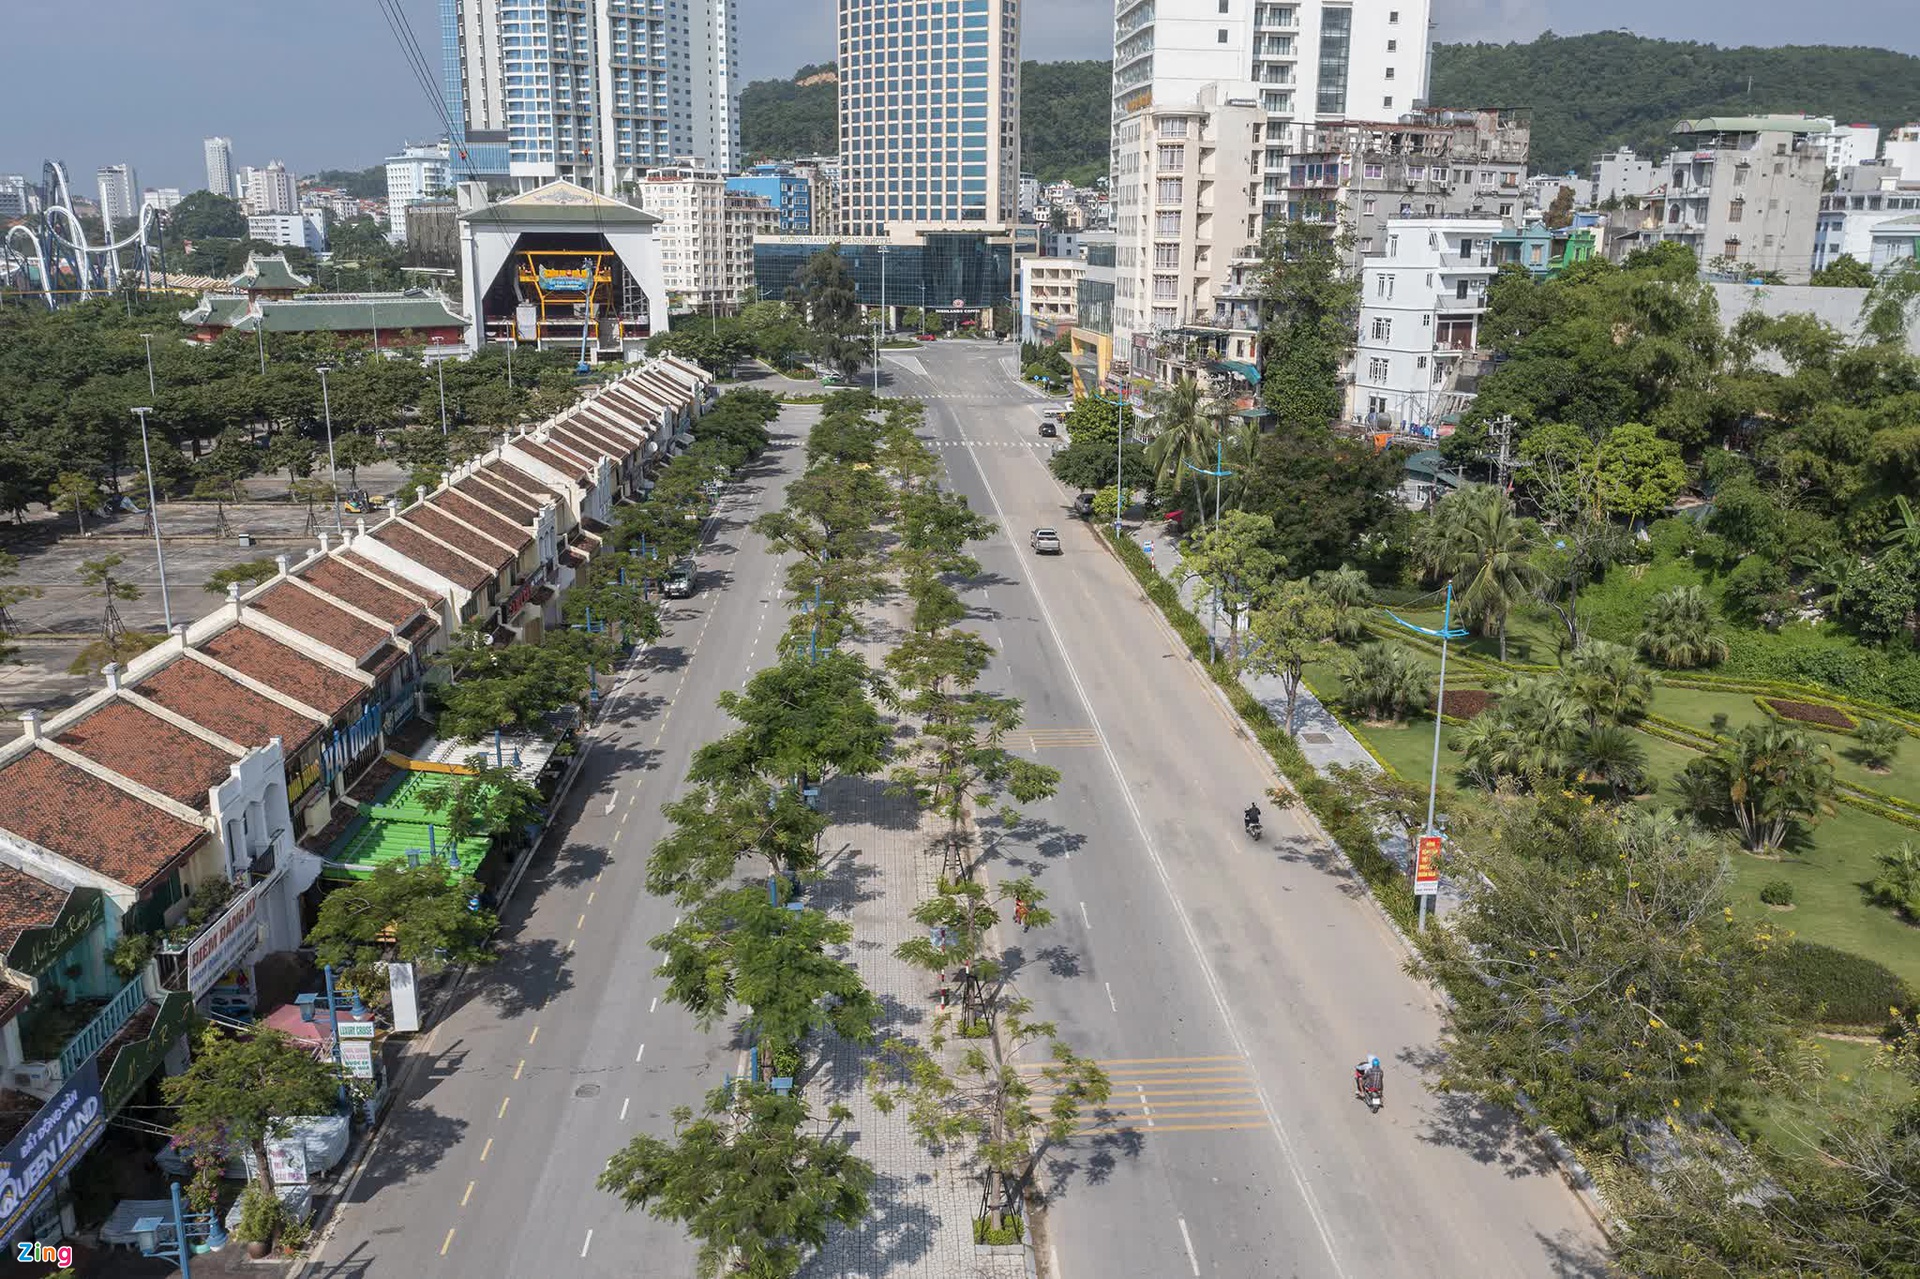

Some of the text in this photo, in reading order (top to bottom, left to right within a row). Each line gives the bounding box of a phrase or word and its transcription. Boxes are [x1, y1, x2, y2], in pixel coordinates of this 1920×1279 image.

[340, 1026, 372, 1035] LUXURY CRUISE
[0, 1140, 57, 1219] QUEEN
[57, 1096, 98, 1154] LAND
[20, 1132, 38, 1159] BẤT
